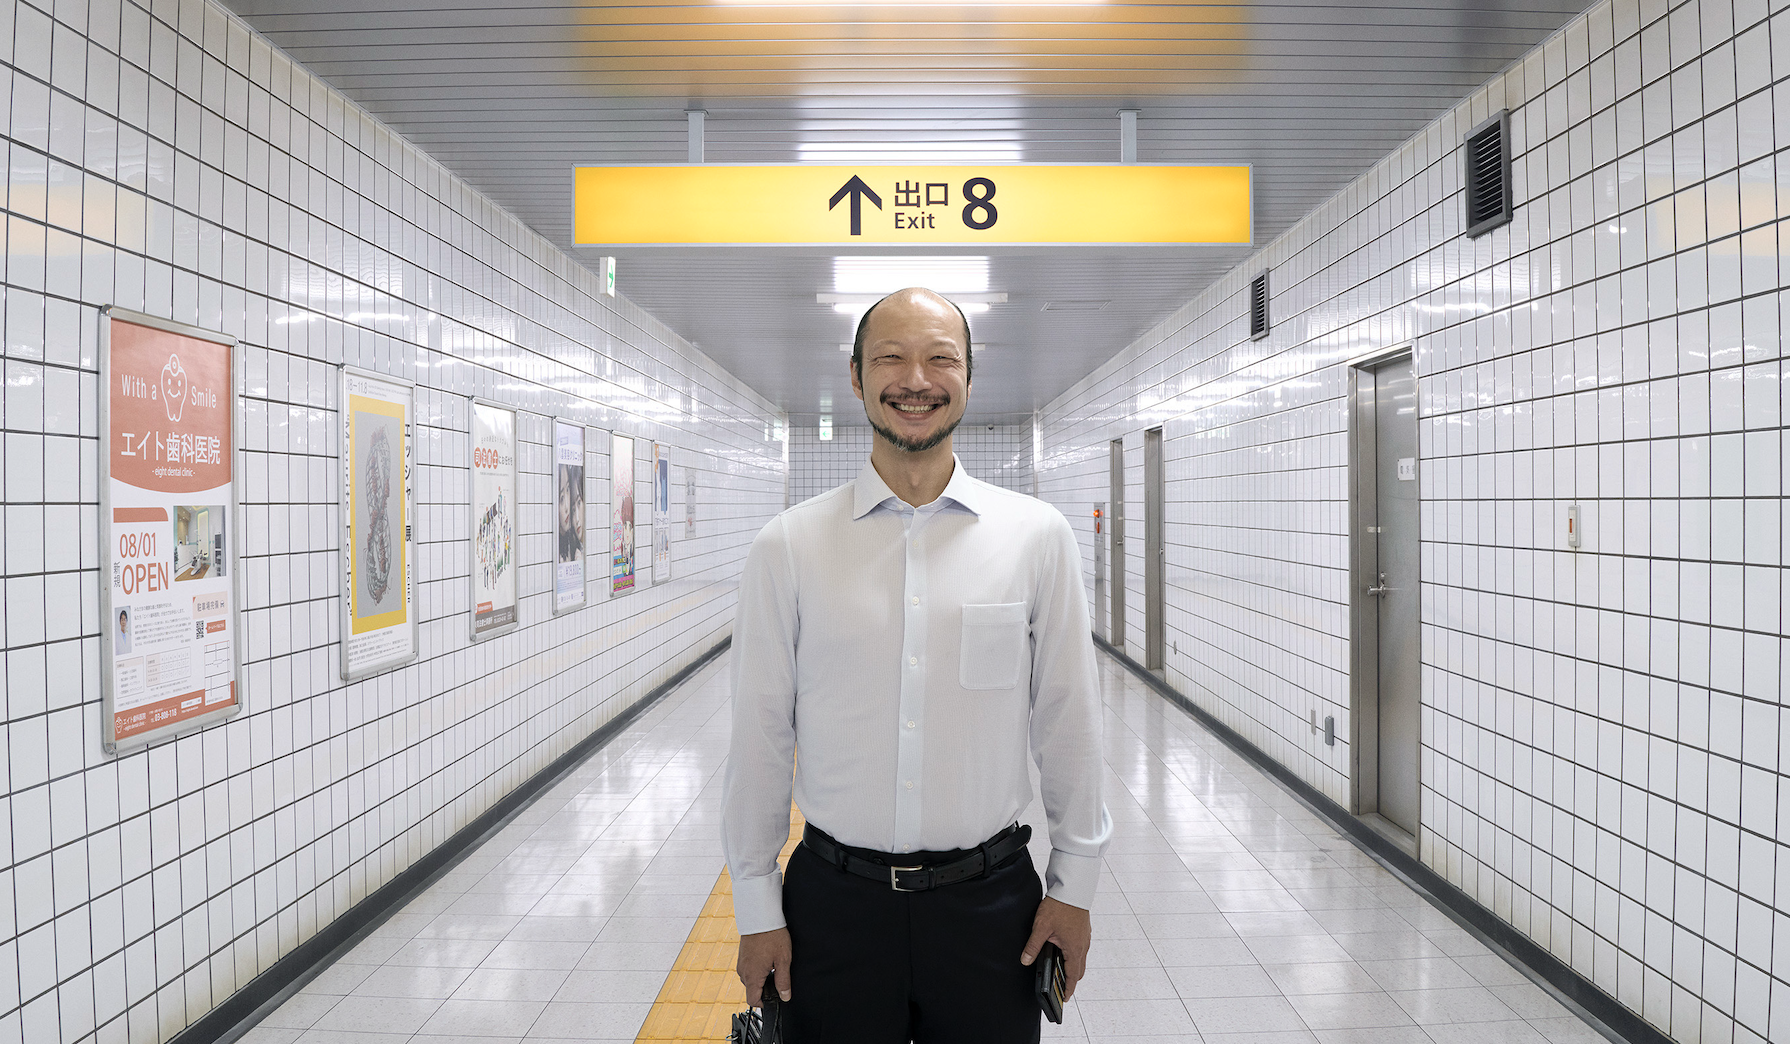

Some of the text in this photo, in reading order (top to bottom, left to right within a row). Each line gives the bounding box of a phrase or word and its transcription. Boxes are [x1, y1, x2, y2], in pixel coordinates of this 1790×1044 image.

[894, 180, 949, 208] 出口
[962, 177, 998, 230] 8
[894, 211, 936, 229] Exit
[121, 374, 217, 408] With a Smile
[121, 431, 221, 464] エイト歯科医院
[168, 467, 181, 477] dental
[120, 532, 156, 558] 08/01
[122, 562, 169, 595] OPEN
